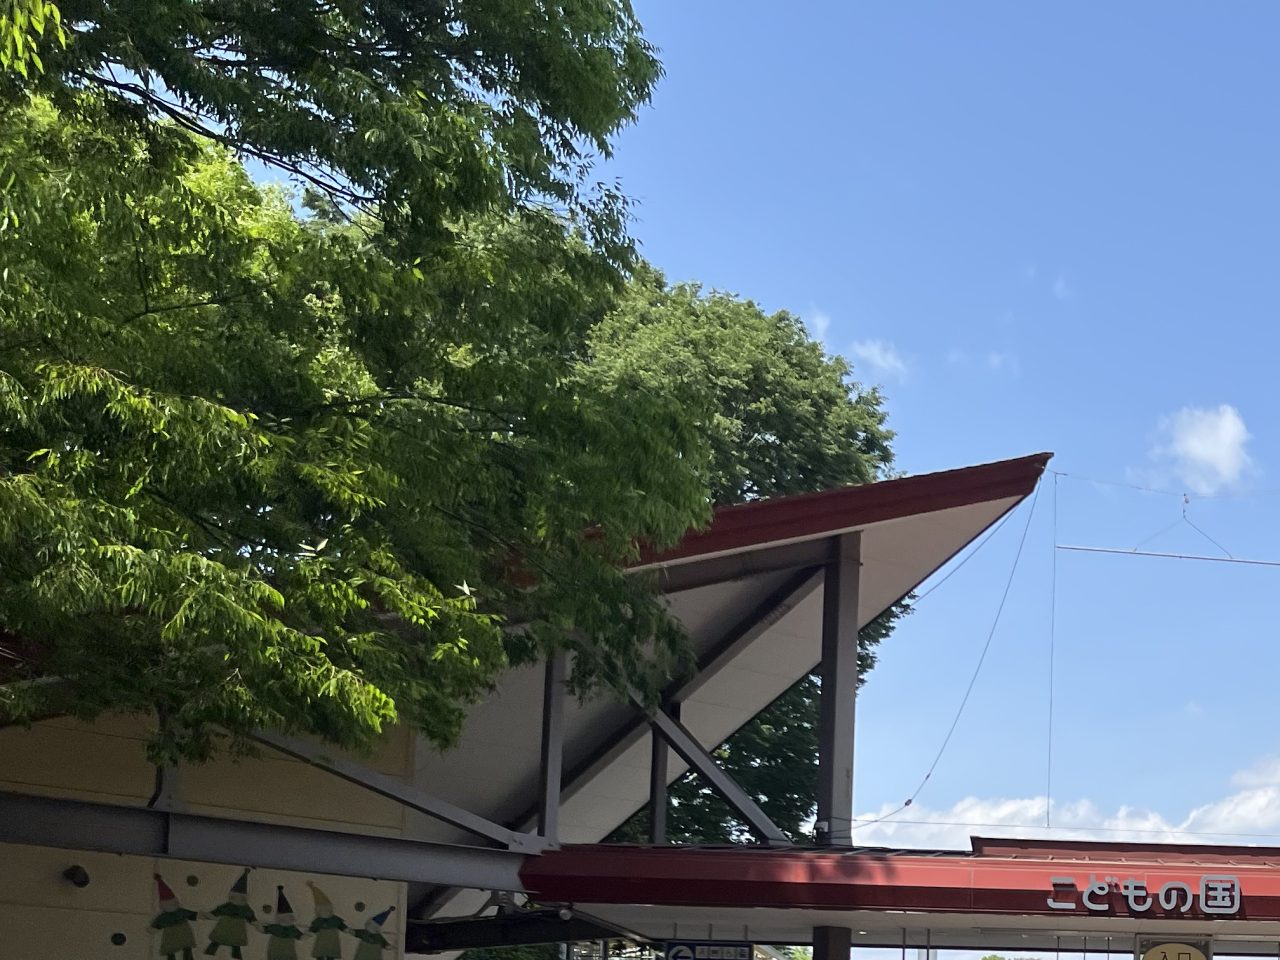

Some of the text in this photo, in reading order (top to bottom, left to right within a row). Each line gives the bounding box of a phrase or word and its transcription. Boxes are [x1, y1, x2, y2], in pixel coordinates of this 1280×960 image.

[1047, 874, 1241, 914] こどもの国
